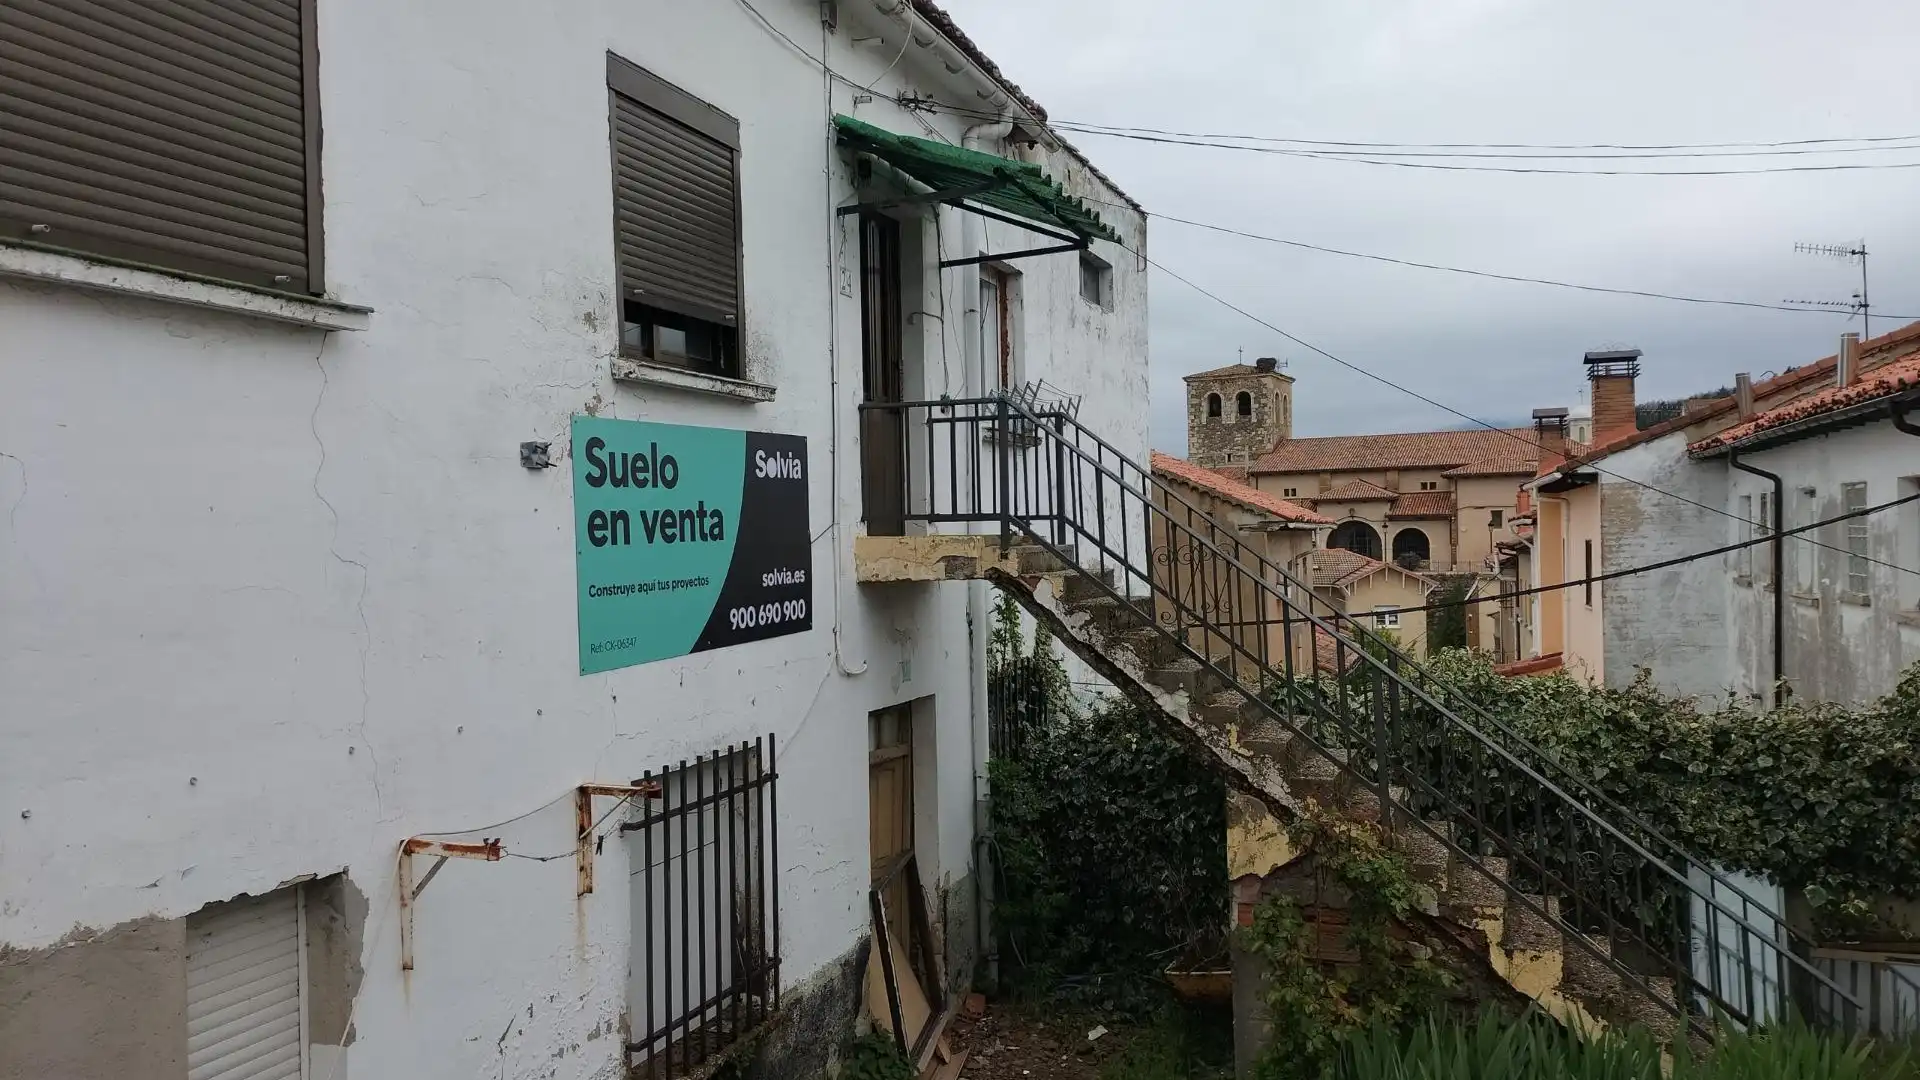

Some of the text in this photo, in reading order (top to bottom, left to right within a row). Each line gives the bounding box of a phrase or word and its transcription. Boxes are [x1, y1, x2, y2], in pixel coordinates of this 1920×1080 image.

[584, 436, 679, 490] Suelo
[755, 449, 802, 480] Solvia
[587, 500, 724, 548] en venta
[588, 575, 710, 598] Construye aquí tus proyectos
[762, 567, 805, 587] solvia.es
[729, 598, 806, 630] 900 690 900
